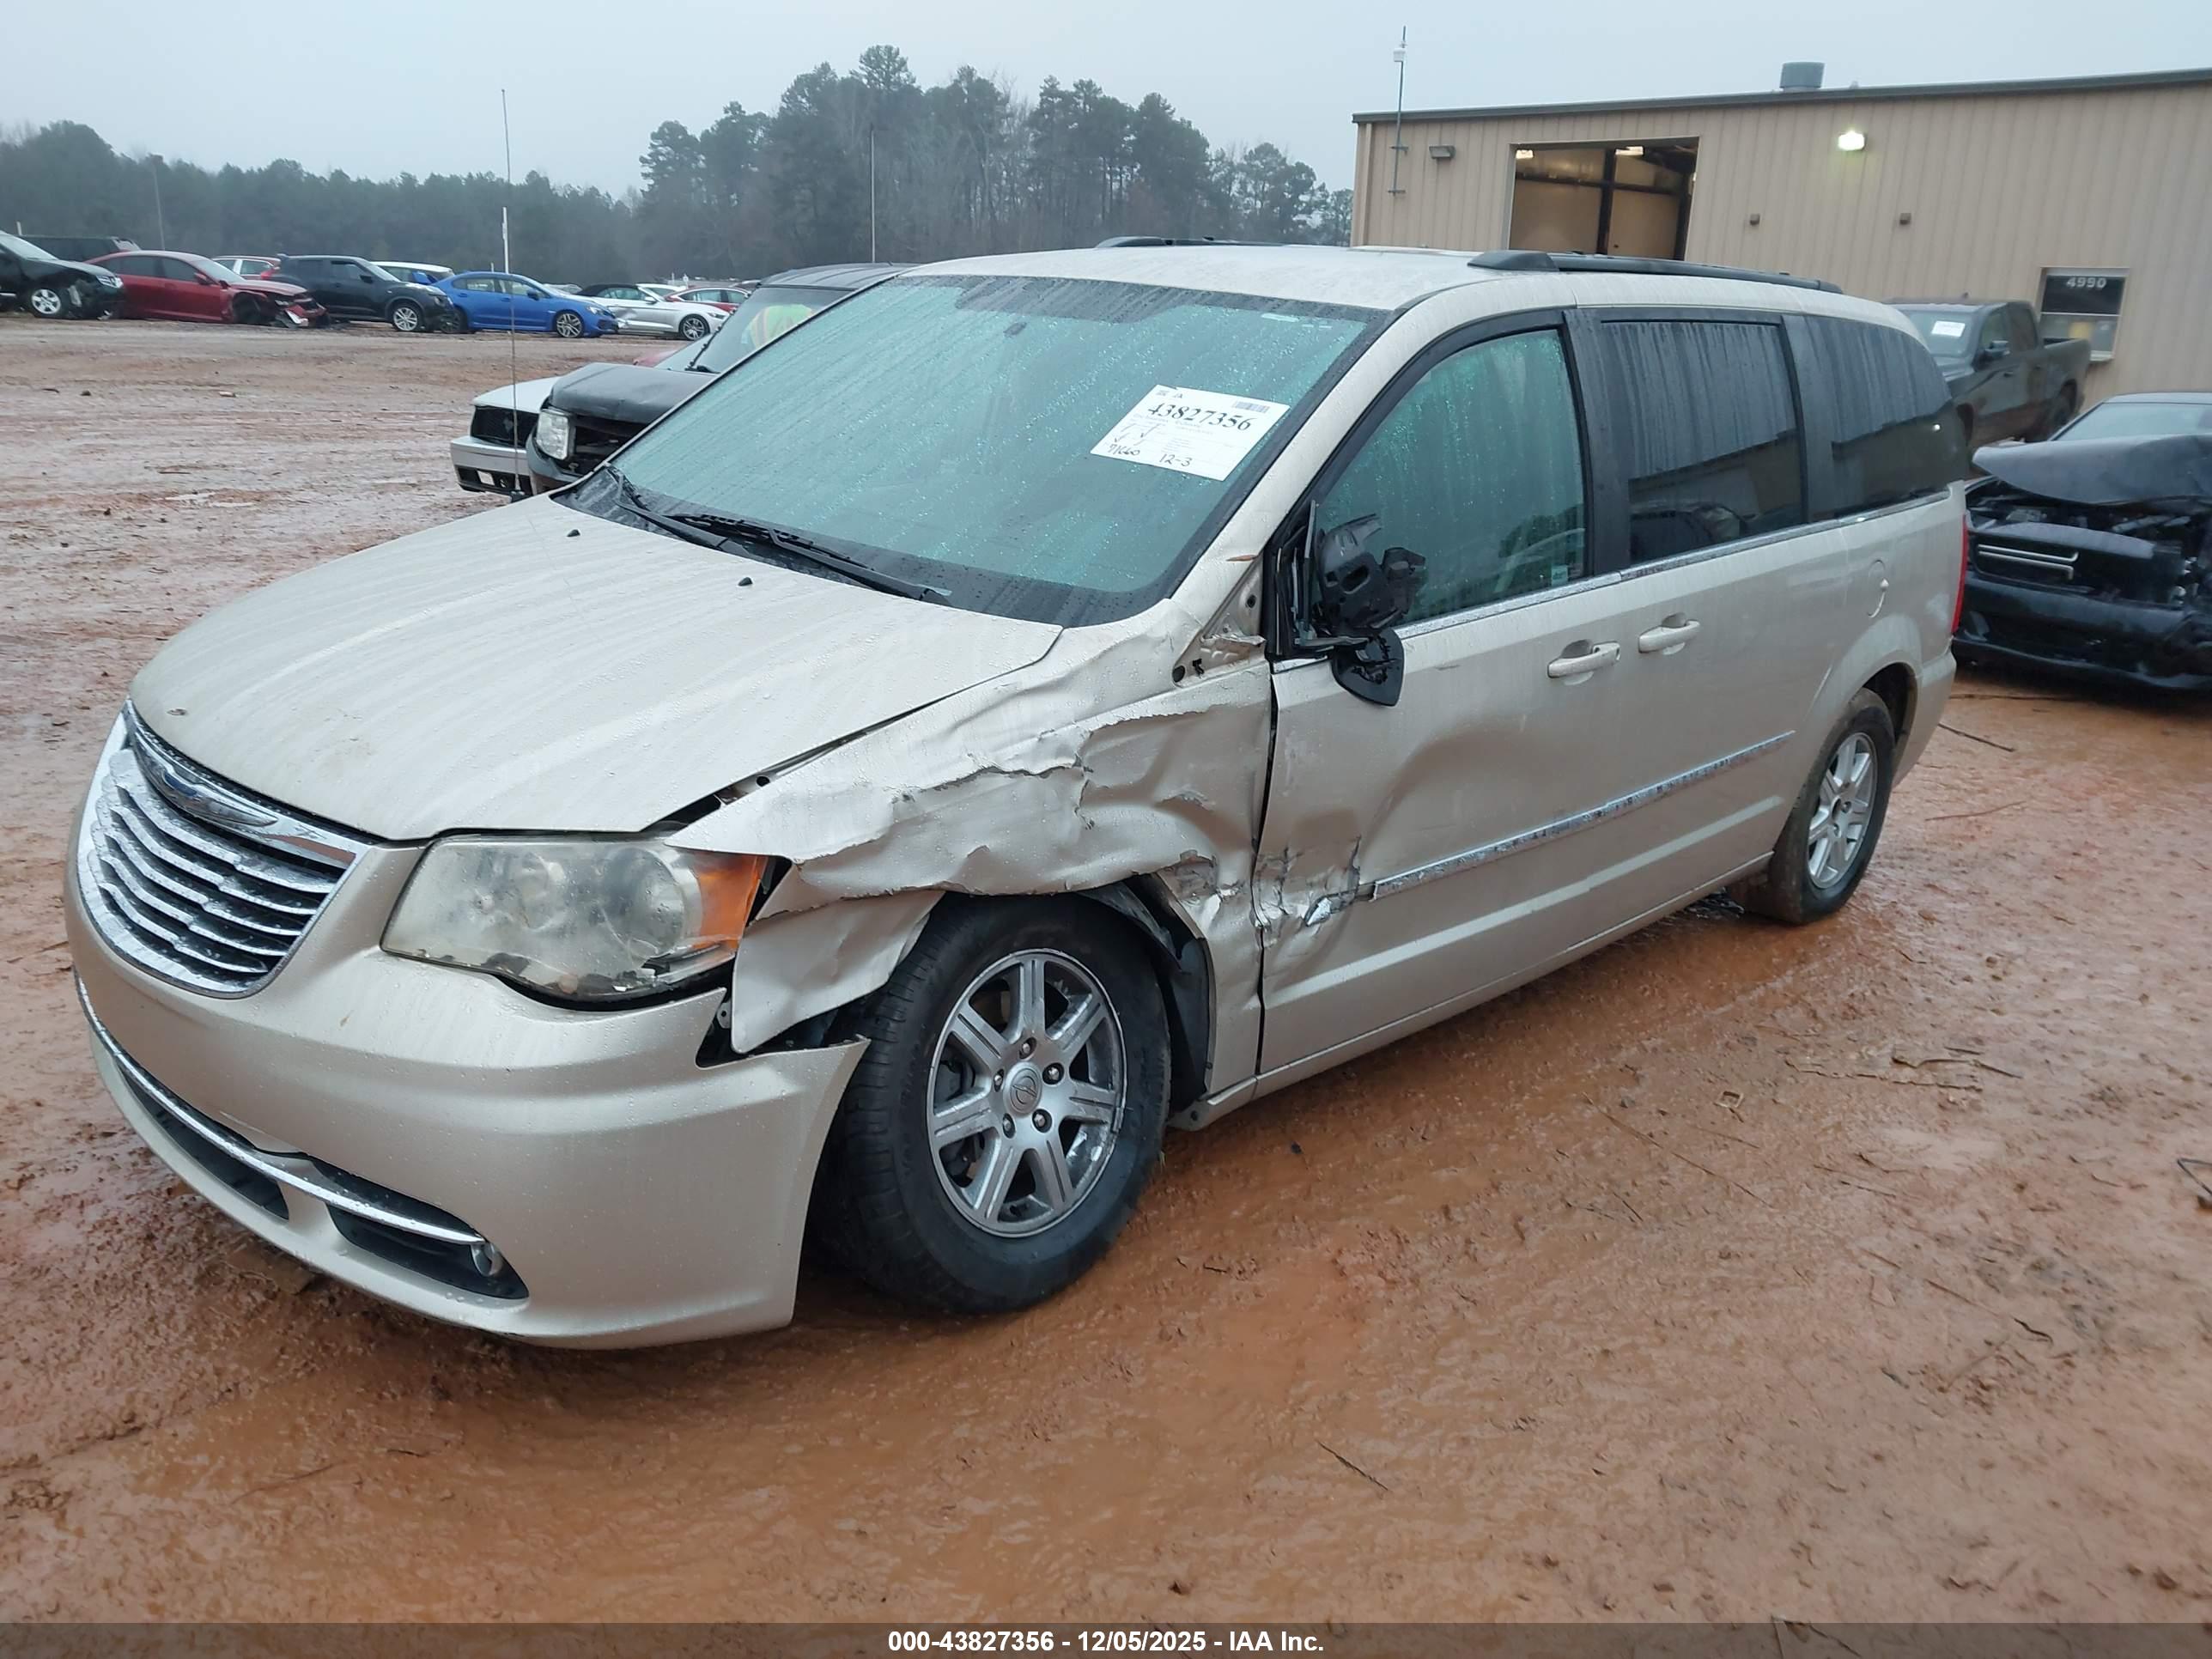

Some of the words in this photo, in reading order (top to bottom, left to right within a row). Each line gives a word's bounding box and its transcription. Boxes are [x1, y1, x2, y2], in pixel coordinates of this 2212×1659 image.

[2065, 276, 2107, 289] 4990
[1147, 402, 1258, 431] 43827356
[1158, 453, 1193, 467] 12-3
